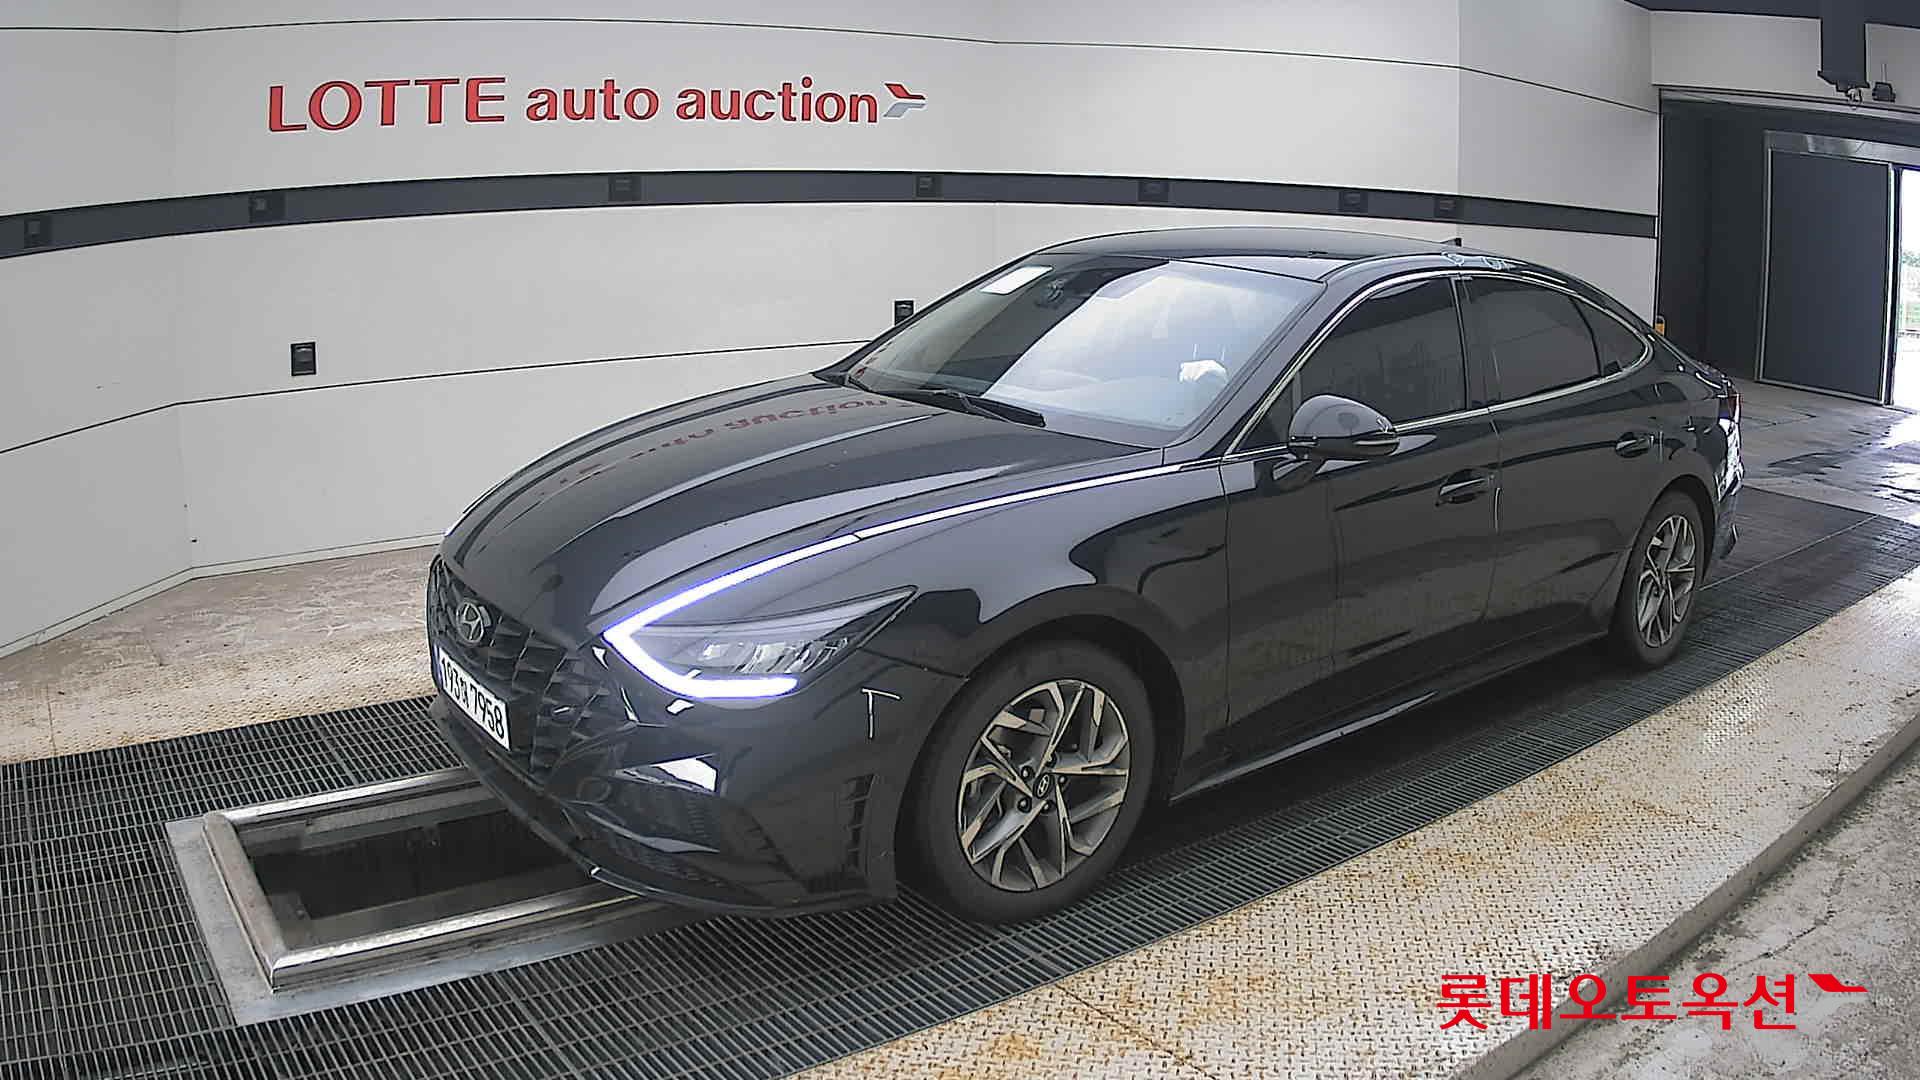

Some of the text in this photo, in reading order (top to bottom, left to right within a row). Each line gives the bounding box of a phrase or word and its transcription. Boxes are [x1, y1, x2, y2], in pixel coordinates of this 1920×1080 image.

[267, 76, 879, 133] LOTTE auto auction
[470, 682, 505, 740] 7958
